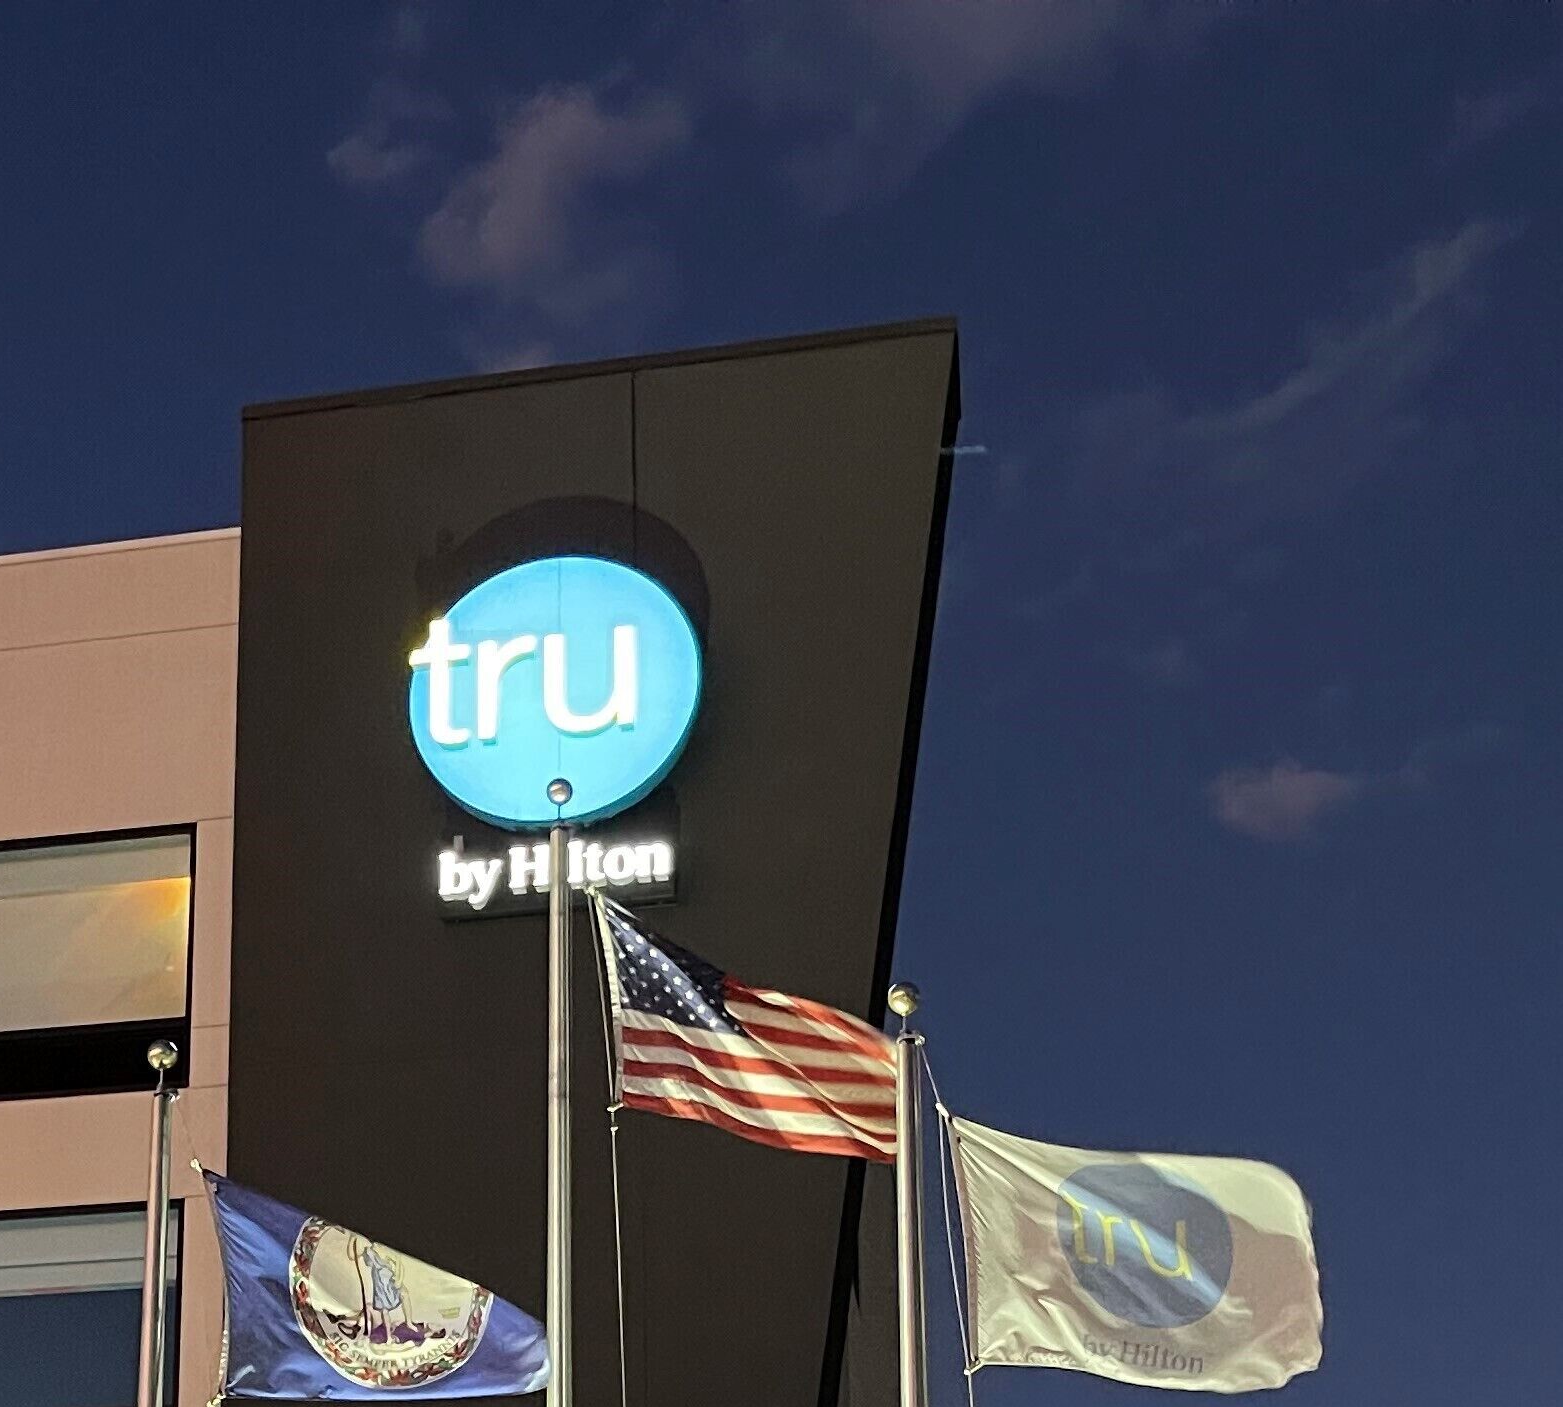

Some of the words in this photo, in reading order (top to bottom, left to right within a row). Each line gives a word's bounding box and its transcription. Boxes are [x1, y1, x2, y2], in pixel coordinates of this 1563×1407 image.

[408, 617, 639, 748] tru
[438, 849, 502, 910] by
[508, 839, 674, 896] Hlton
[1120, 1340, 1205, 1375] Hilton
